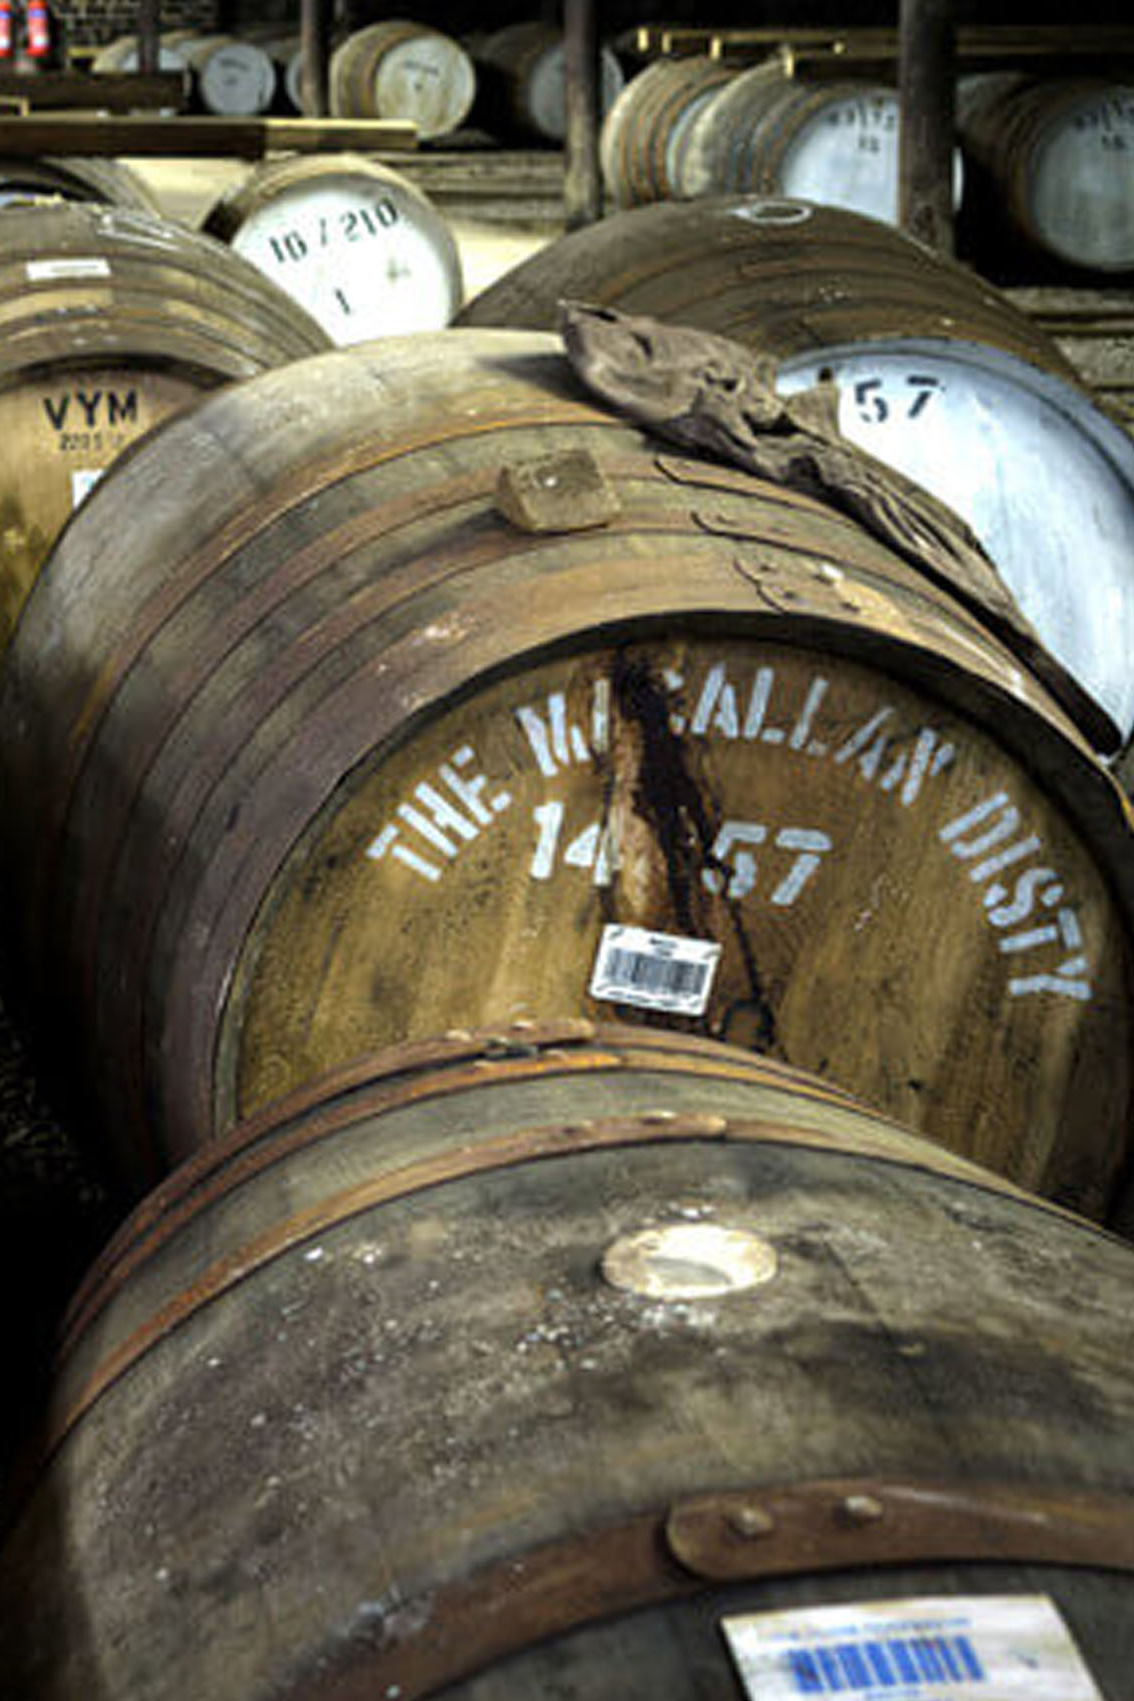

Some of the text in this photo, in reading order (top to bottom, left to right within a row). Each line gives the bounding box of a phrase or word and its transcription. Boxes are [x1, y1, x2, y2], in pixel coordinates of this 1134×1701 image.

[339, 196, 398, 242] 210
[43, 388, 138, 431] VYM
[366, 662, 1093, 1001] THE MALLAN DISTY
[530, 800, 833, 906] 1457
